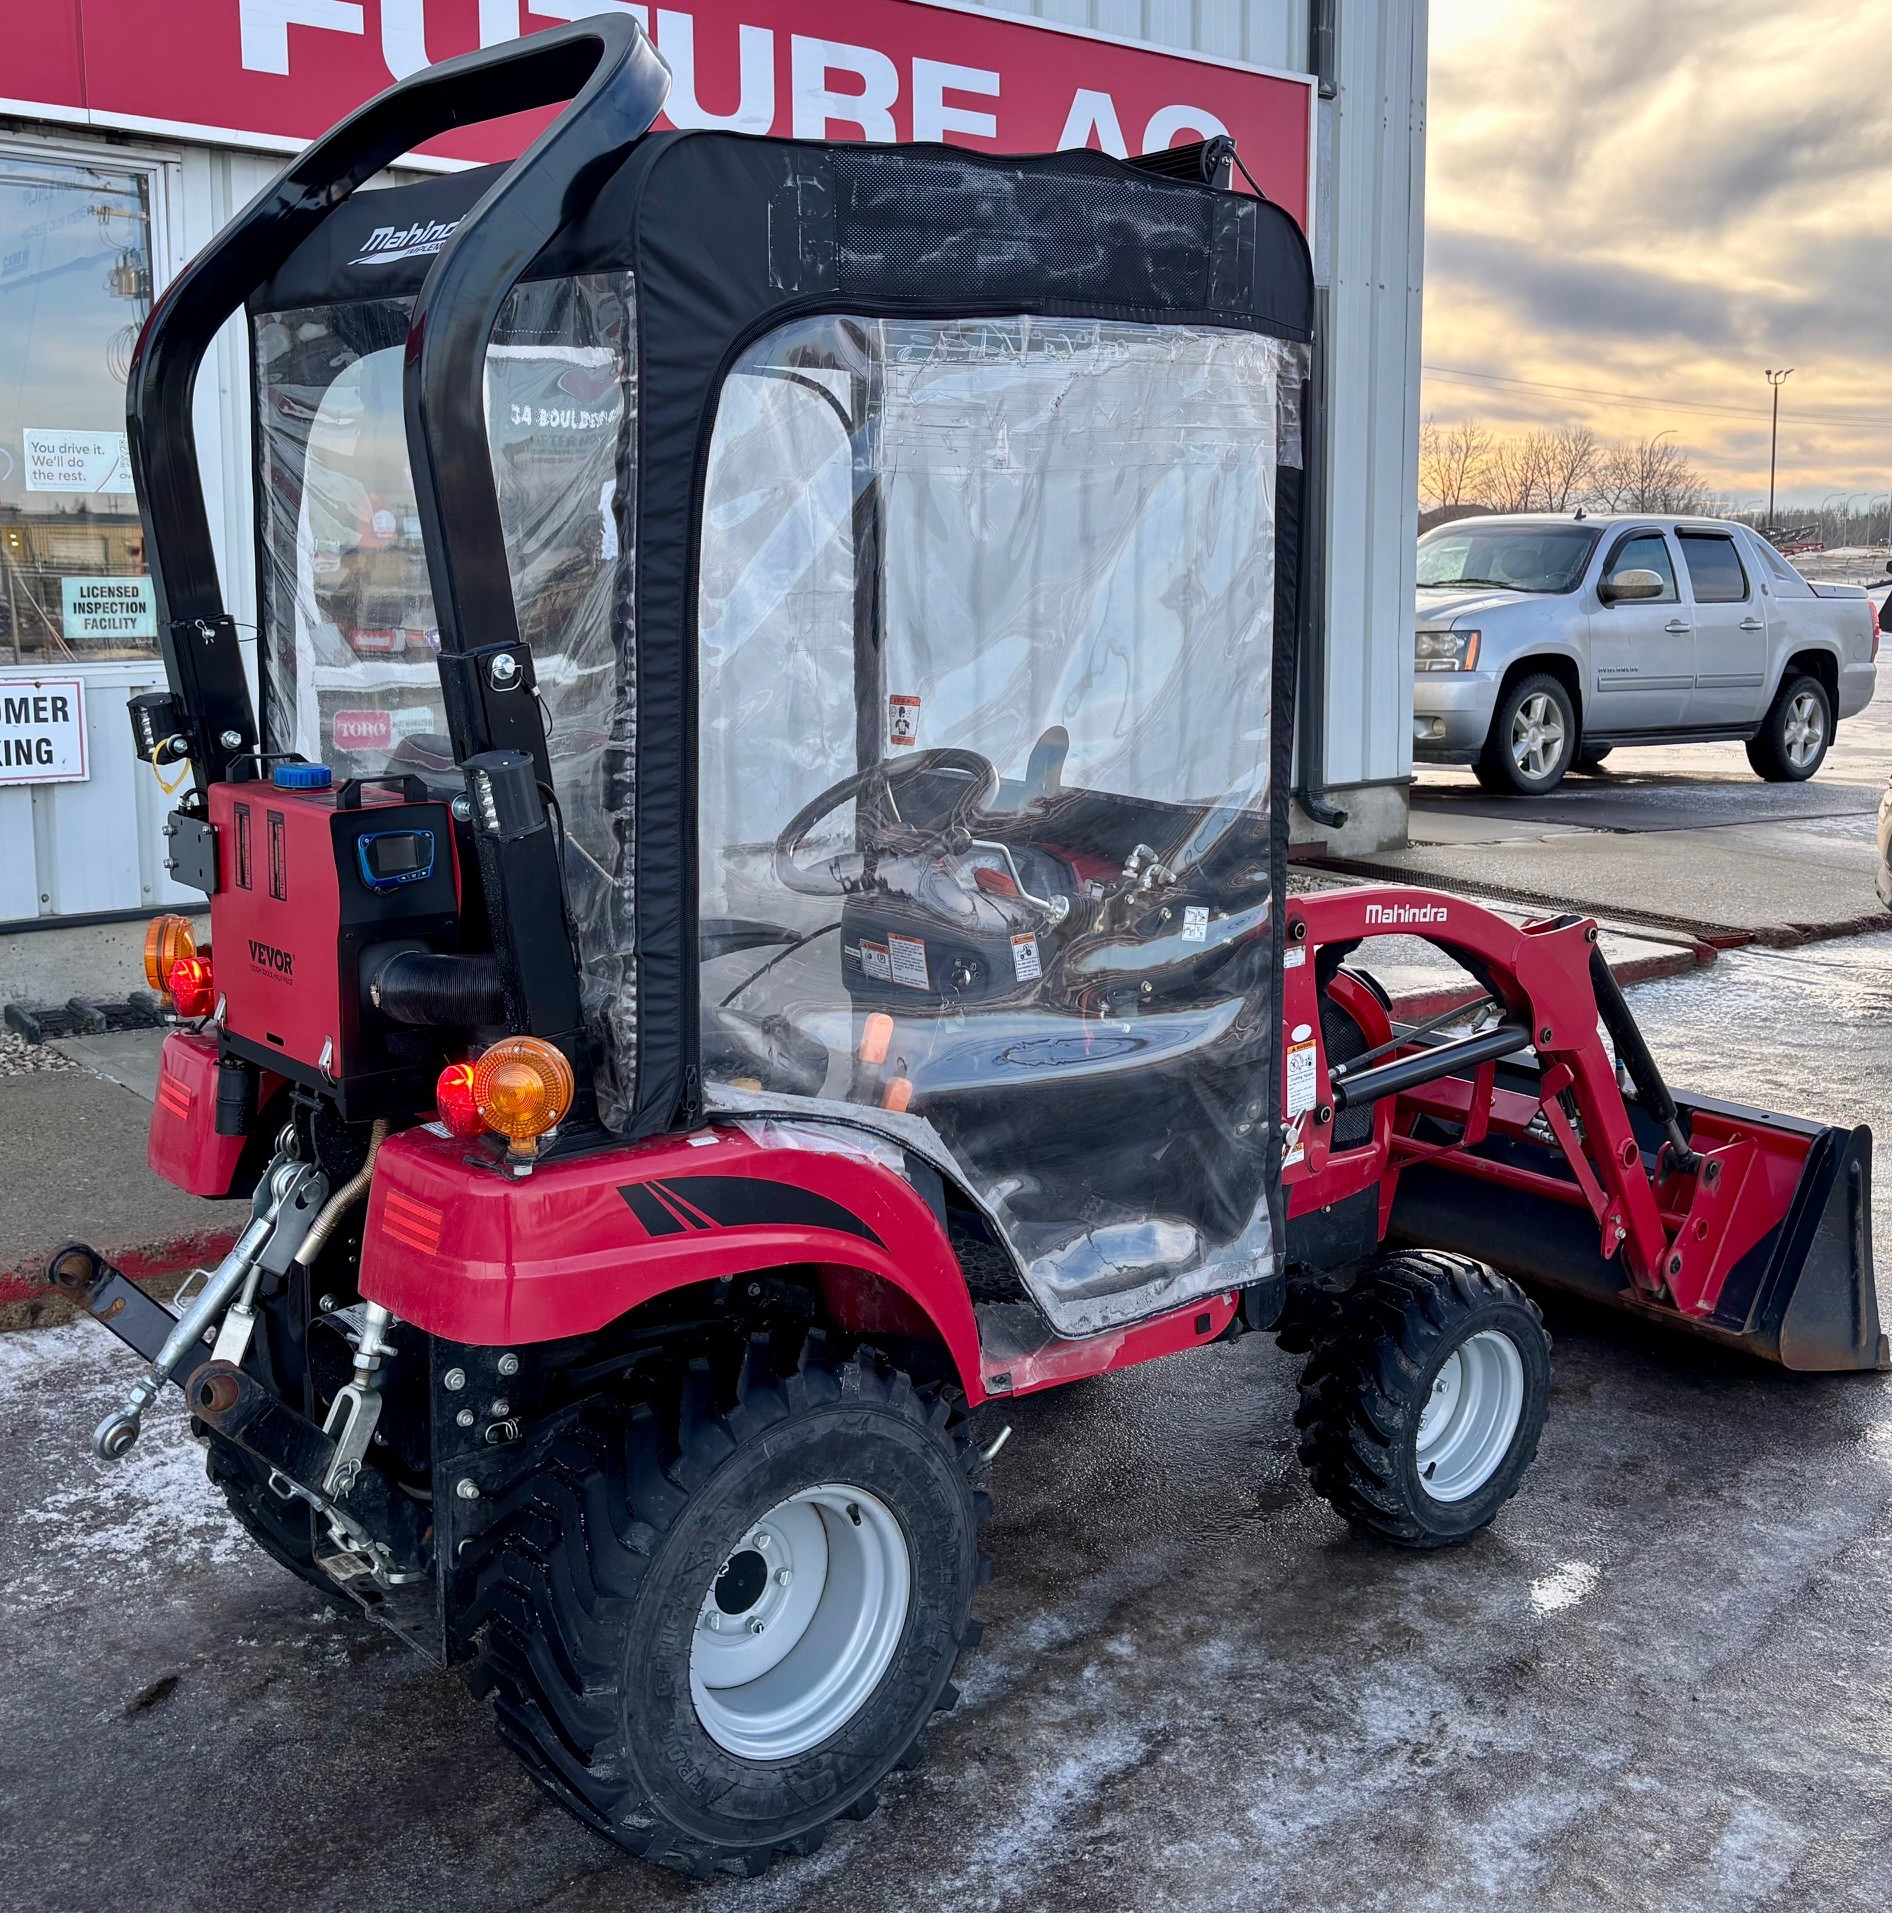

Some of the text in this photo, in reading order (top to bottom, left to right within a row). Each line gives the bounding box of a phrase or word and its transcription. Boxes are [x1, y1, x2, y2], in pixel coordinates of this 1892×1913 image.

[239, 0, 1001, 147] FUURE
[31, 441, 105, 455] You drive it.
[32, 455, 84, 468] We'll do
[32, 469, 87, 481] the rest.
[80, 586, 139, 598] LICENSED
[73, 601, 147, 614] INSPECTION
[84, 617, 138, 631] FACILITY
[0, 696, 70, 724] MER
[0, 737, 54, 767] ING
[1365, 903, 1448, 924] Mahindra
[248, 938, 293, 976] VEVOR
